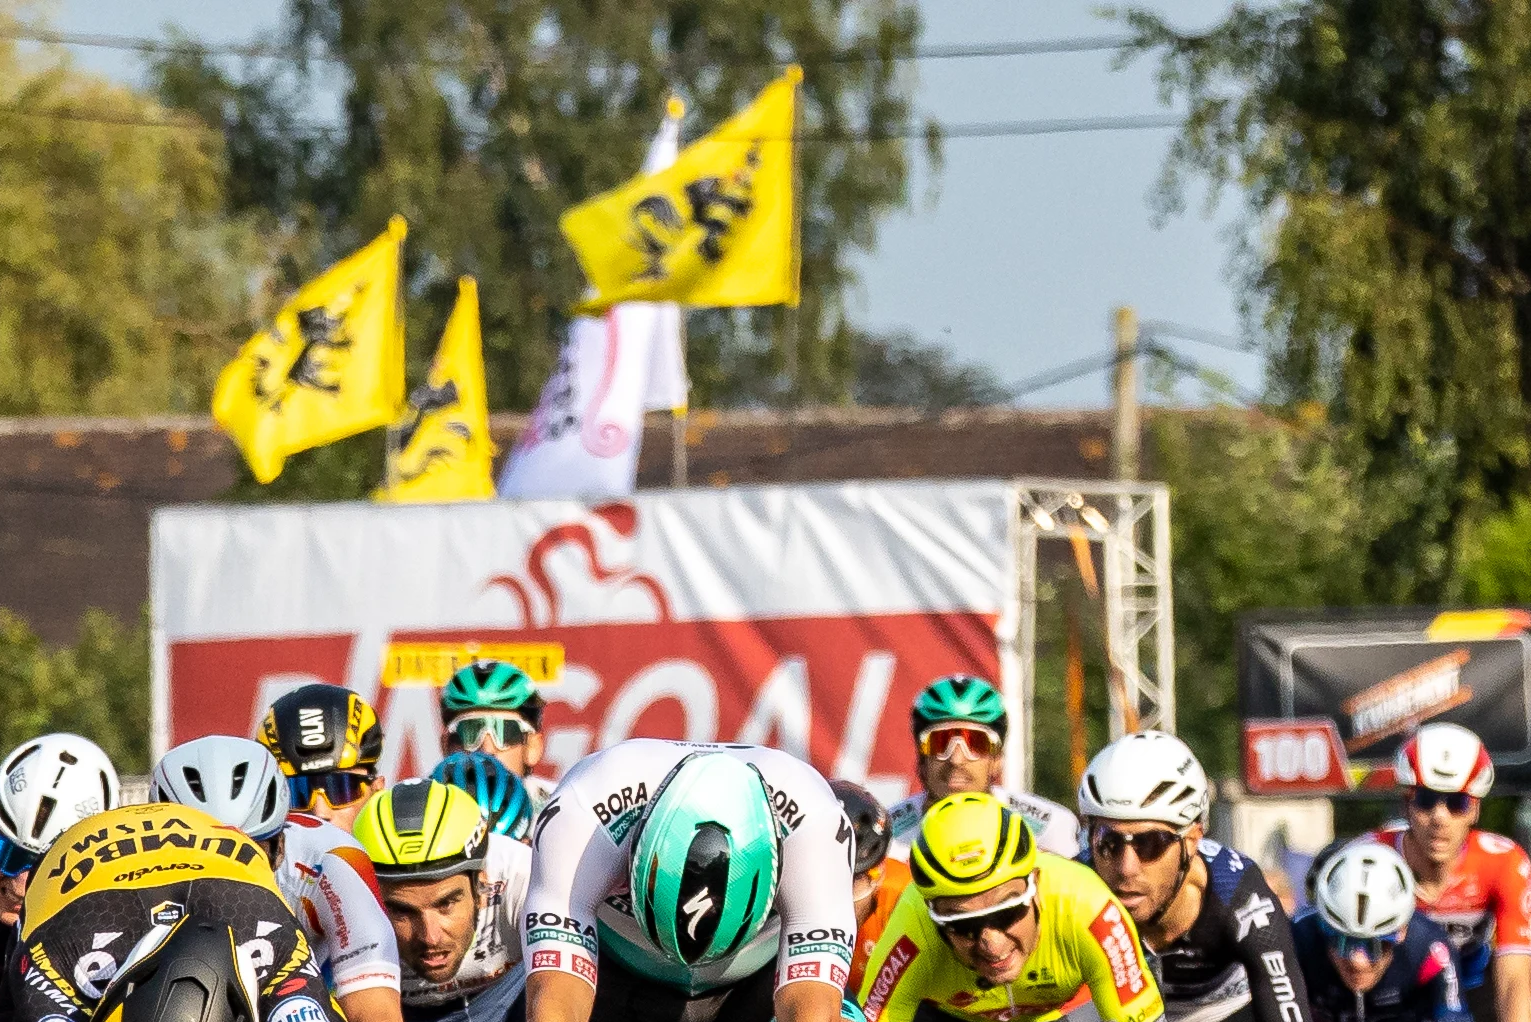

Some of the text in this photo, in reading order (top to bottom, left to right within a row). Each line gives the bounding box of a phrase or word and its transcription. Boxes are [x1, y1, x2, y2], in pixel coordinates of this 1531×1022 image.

[299, 707, 326, 746] OLAV
[1253, 732, 1331, 784] 100
[74, 796, 101, 819] SEG
[593, 781, 648, 827] BORA
[48, 818, 193, 880] VISMA
[60, 832, 266, 895] JUMBO
[526, 912, 597, 940] BORA
[528, 928, 597, 952] hansgrohe
[788, 928, 854, 950] BORA
[1102, 904, 1144, 995] Pauwels
